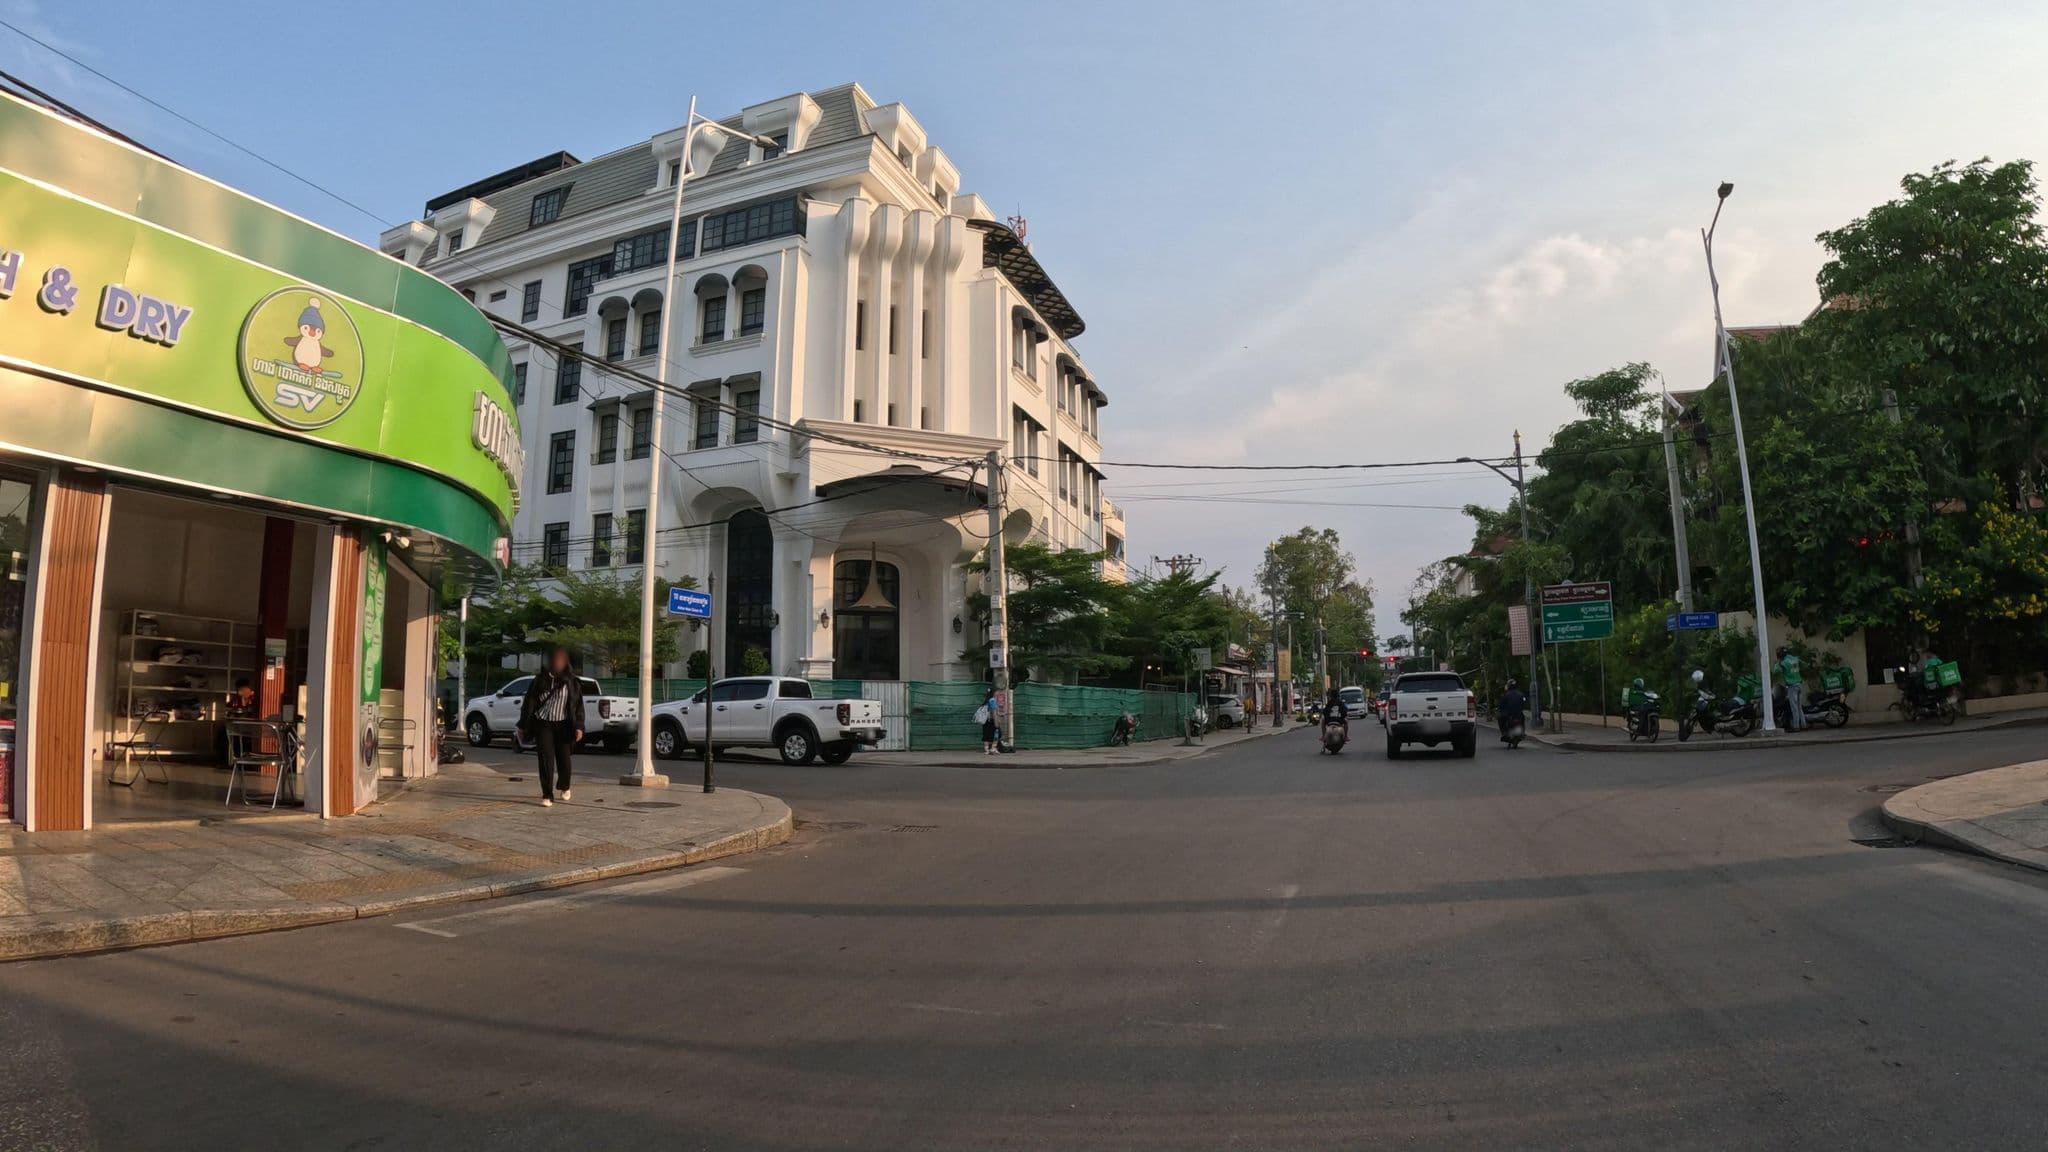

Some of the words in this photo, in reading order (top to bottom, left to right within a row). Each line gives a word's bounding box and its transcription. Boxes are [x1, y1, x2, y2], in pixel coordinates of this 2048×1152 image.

[41, 264, 79, 312] &
[100, 284, 193, 345] DRY
[274, 383, 325, 412] SV
[1399, 711, 1466, 719] RANGER
